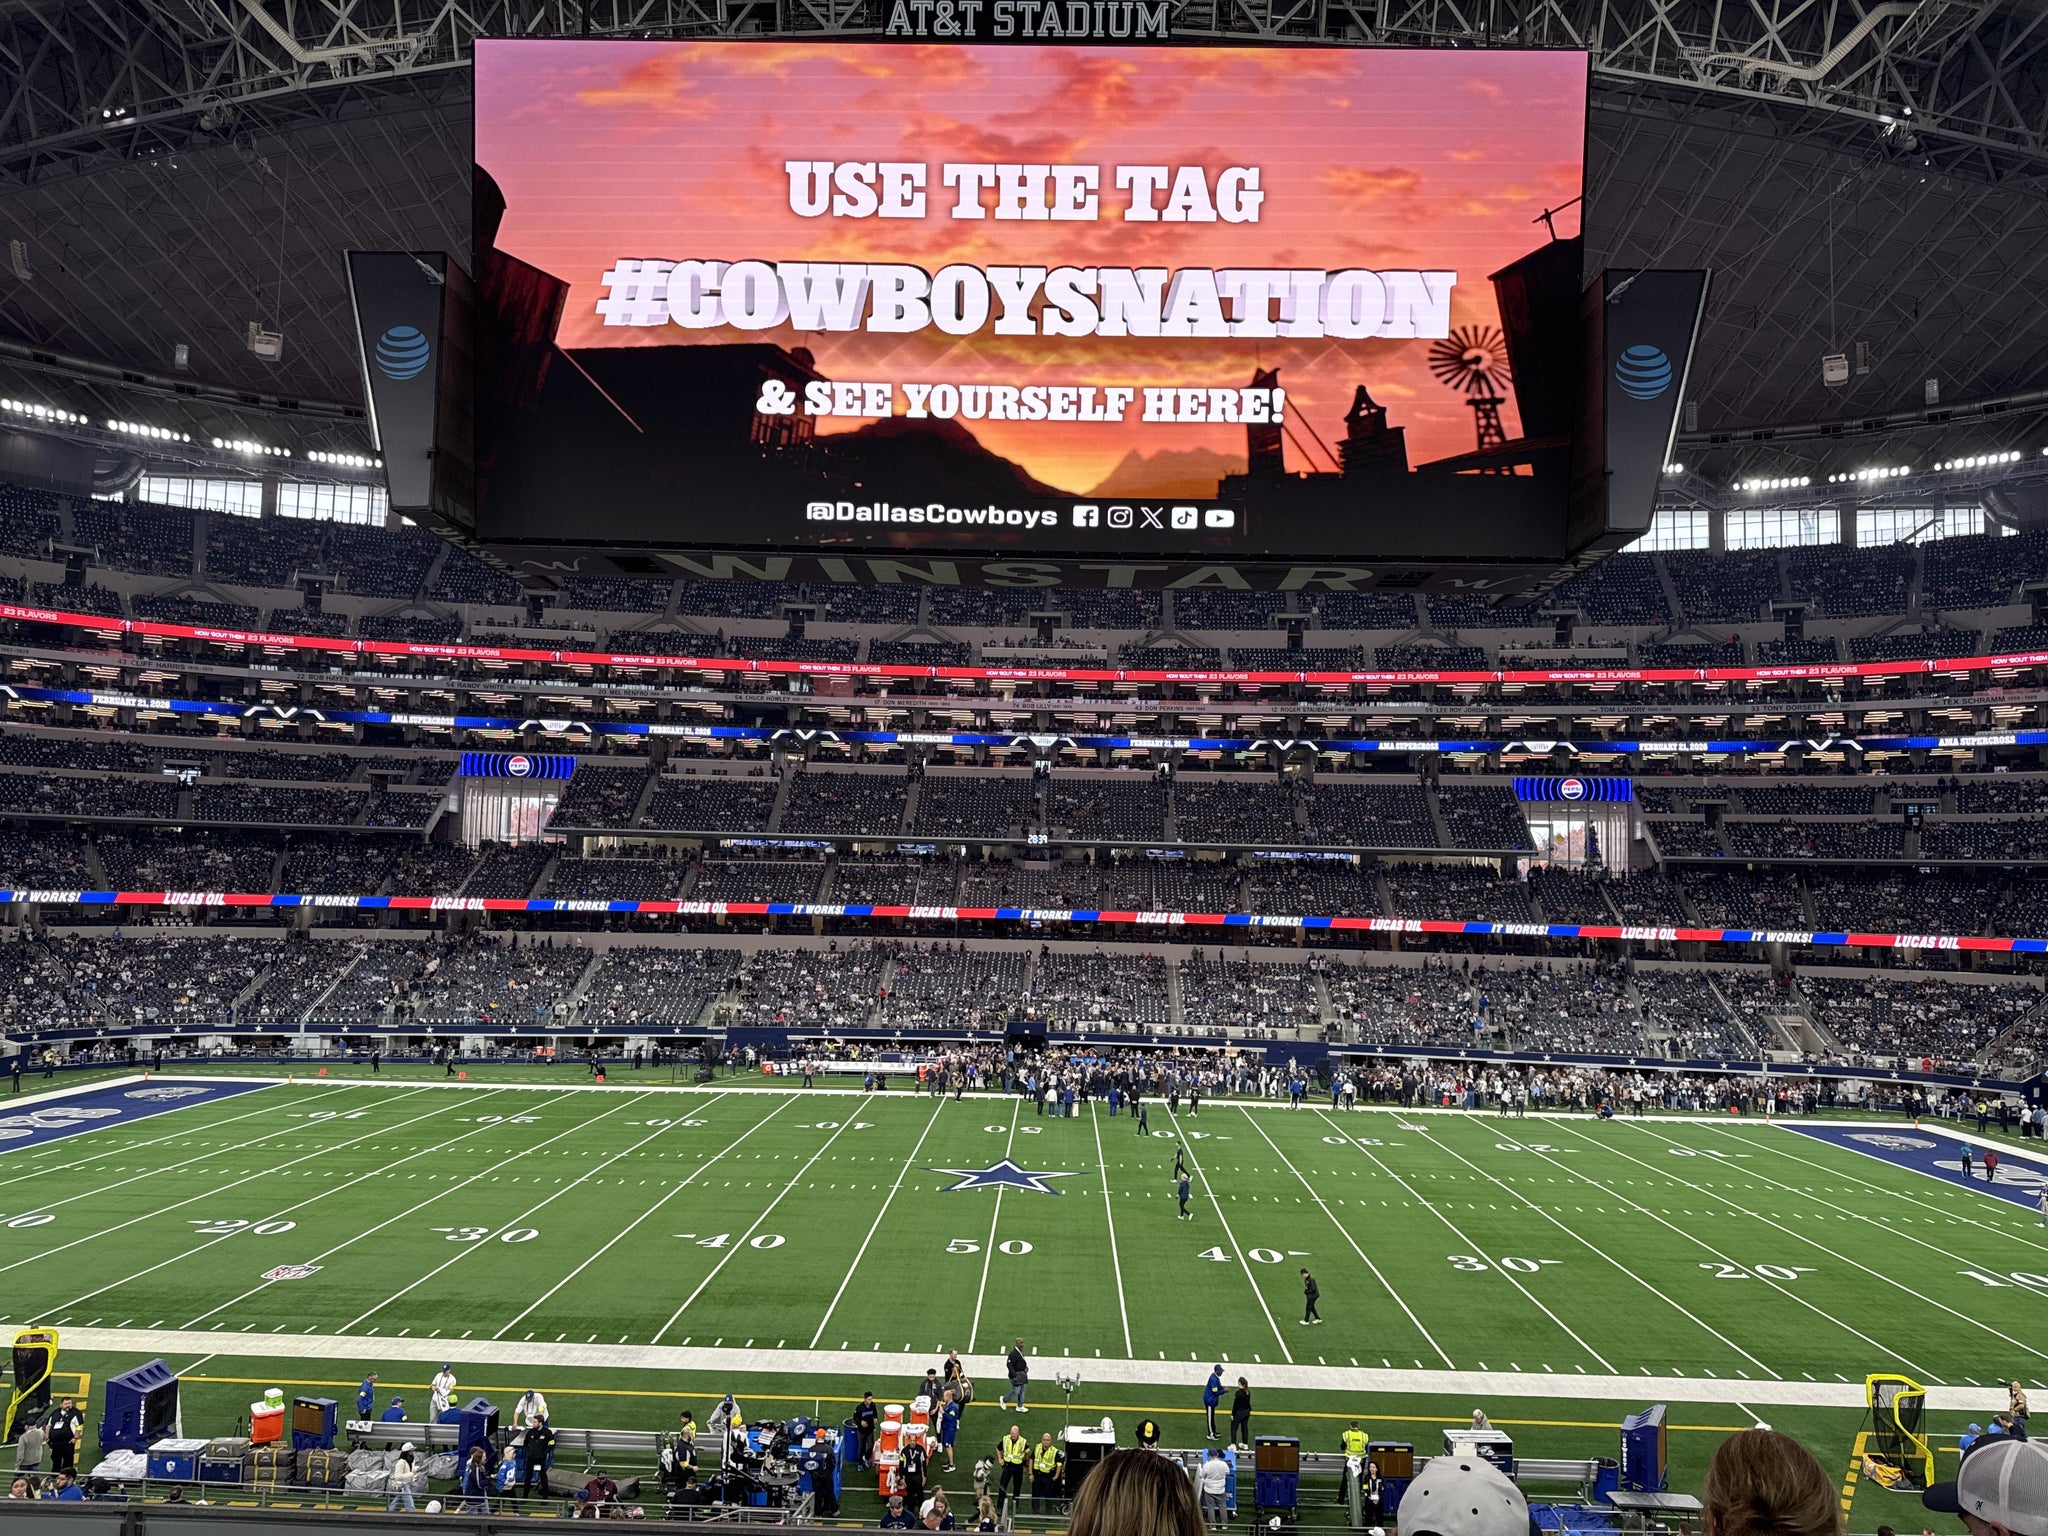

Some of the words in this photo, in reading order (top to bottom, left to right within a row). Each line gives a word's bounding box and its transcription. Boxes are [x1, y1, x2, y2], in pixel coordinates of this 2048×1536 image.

[885, 0, 983, 36] AT&T
[993, 1, 1169, 38] STADIUM
[785, 161, 927, 219] USE
[943, 163, 1099, 221] THE
[1115, 165, 1264, 224] TAG
[595, 258, 1457, 339] #COWBOYSNATION
[756, 380, 796, 415] &
[803, 381, 893, 418] SEE
[901, 383, 1134, 422] YOURSELF
[1142, 387, 1286, 423] HERE!
[806, 502, 1057, 529] @DallasCowboys
[655, 553, 1374, 591] WINSTAR
[4, 608, 16, 616] 23
[17, 609, 58, 621] FLAVORS
[260, 635, 294, 644] FLAVORS
[156, 661, 186, 670] HARRIS
[92, 695, 137, 706] FEBRUARY
[138, 699, 149, 708] 21,
[150, 699, 170, 709] 2026
[1962, 696, 2005, 704] SCHRAMM
[391, 714, 409, 724] AMA
[410, 715, 455, 726] SUPERCROSS
[648, 725, 684, 735] FEBRUARY
[685, 726, 694, 735] 21,
[695, 726, 711, 735] 2026
[896, 733, 913, 742] AMA
[913, 734, 953, 743] SUPERCROSS
[1130, 739, 1163, 748] FEBRUARY
[1163, 740, 1174, 748] 21,
[1174, 740, 1190, 748] 2026
[1938, 737, 1959, 747] AMA
[1960, 736, 2015, 746] SUPERCROSS
[1378, 741, 1395, 750] AMA
[1395, 741, 1439, 750] SUPERCROSS
[1639, 743, 1679, 751] FEBRUARY
[1679, 743, 1689, 751] 21,
[1689, 743, 1708, 751] 2026
[11, 892, 25, 902] IT
[29, 891, 81, 903] WORKS!
[163, 892, 203, 905] LUCAS
[205, 893, 226, 905] OIL
[300, 896, 313, 906] IT
[315, 896, 360, 907] WORKS!
[430, 897, 467, 910] LUCAS
[469, 898, 486, 910] OIL
[553, 900, 566, 910] IT
[568, 900, 611, 911] WORKS!
[676, 901, 710, 913] LUCAS
[712, 902, 729, 913] OIL
[792, 905, 804, 914] IT
[806, 905, 846, 915] WORKS!
[908, 906, 941, 918] LUCAS
[942, 907, 959, 918] OIL
[1020, 910, 1032, 919] IT
[1033, 910, 1073, 920] WORKS!
[1135, 911, 1168, 923] LUCAS
[1170, 912, 1186, 924] OIL
[1249, 915, 1261, 925] IT
[1263, 916, 1303, 927] WORKS!
[1369, 918, 1403, 931] LUCAS
[1405, 919, 1423, 932] OIL
[1491, 924, 1504, 934] IT
[1505, 924, 1550, 935] WORKS!
[1620, 927, 1657, 939] LUCAS
[1659, 928, 1678, 940] OIL
[1750, 931, 1765, 942] IT
[1766, 932, 1814, 943] WORKS!
[1894, 935, 1936, 948] LUCAS
[1939, 936, 1960, 949] OIL
